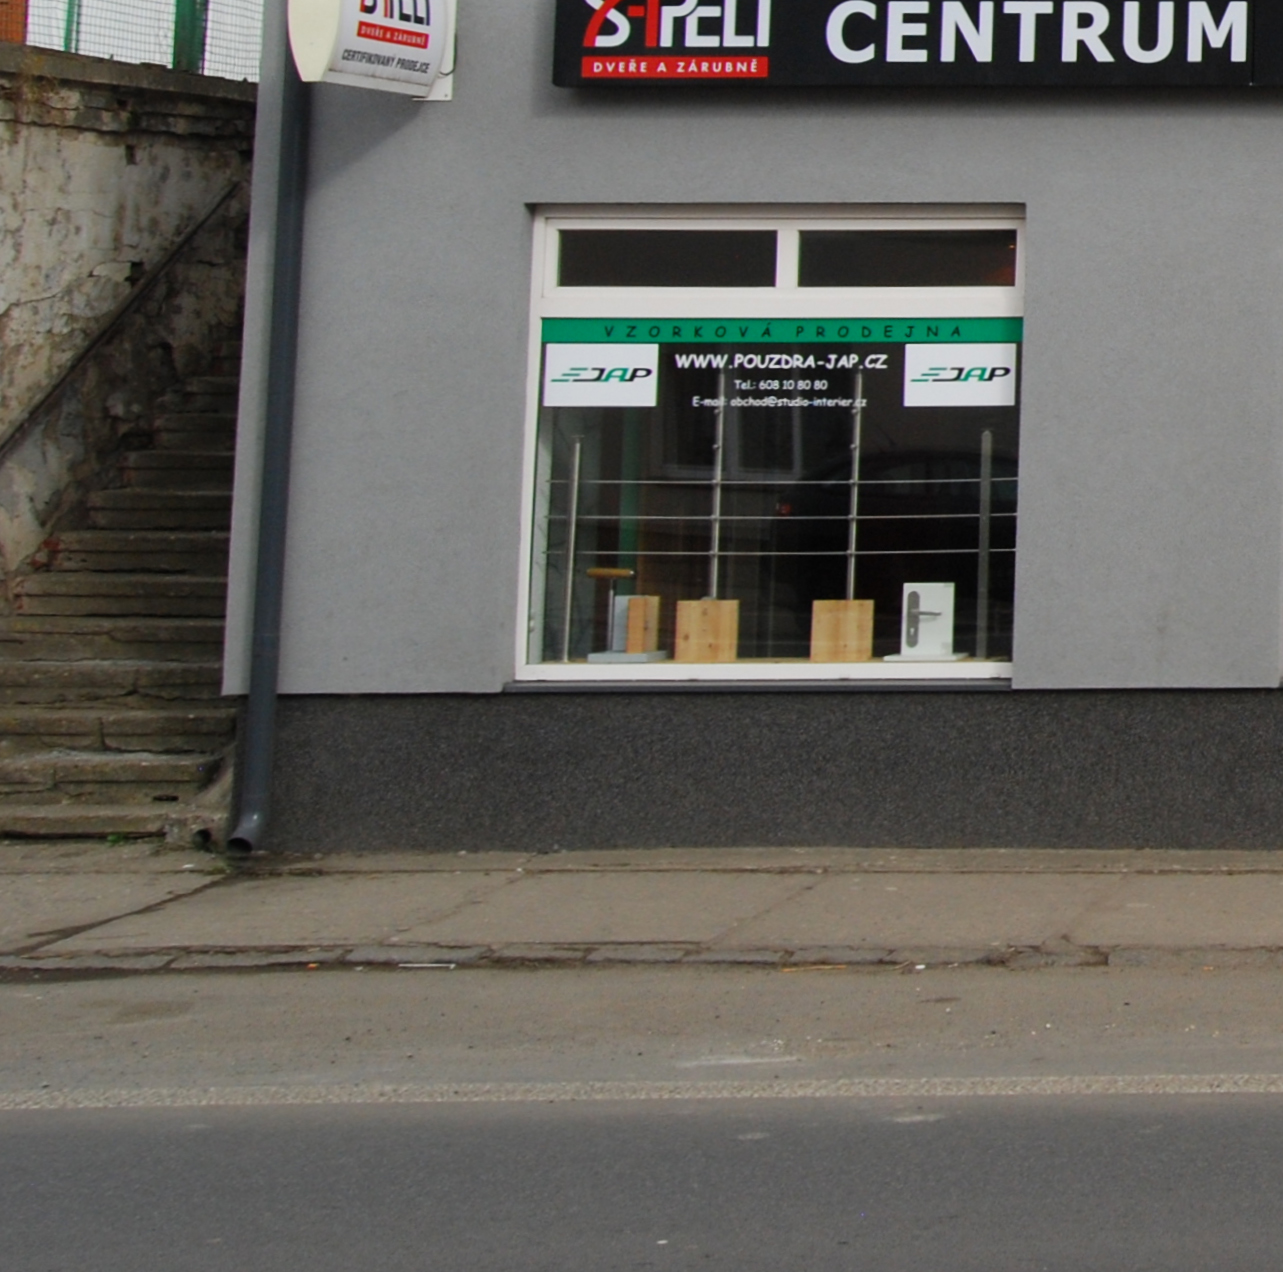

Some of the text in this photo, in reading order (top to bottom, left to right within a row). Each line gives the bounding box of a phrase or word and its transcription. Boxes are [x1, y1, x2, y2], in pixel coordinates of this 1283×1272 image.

[825, 0, 1249, 64] CENTRUM
[396, 57, 430, 73] PRODEJCE
[593, 58, 759, 73] DVEŘE A ZÁRUBNĚ
[604, 322, 962, 339] VZORKOVÁ PRODEJNA
[675, 353, 888, 370] WWW.POUZDRA-JAP.CZ
[734, 380, 828, 390] Tel.: 608 10 80 80
